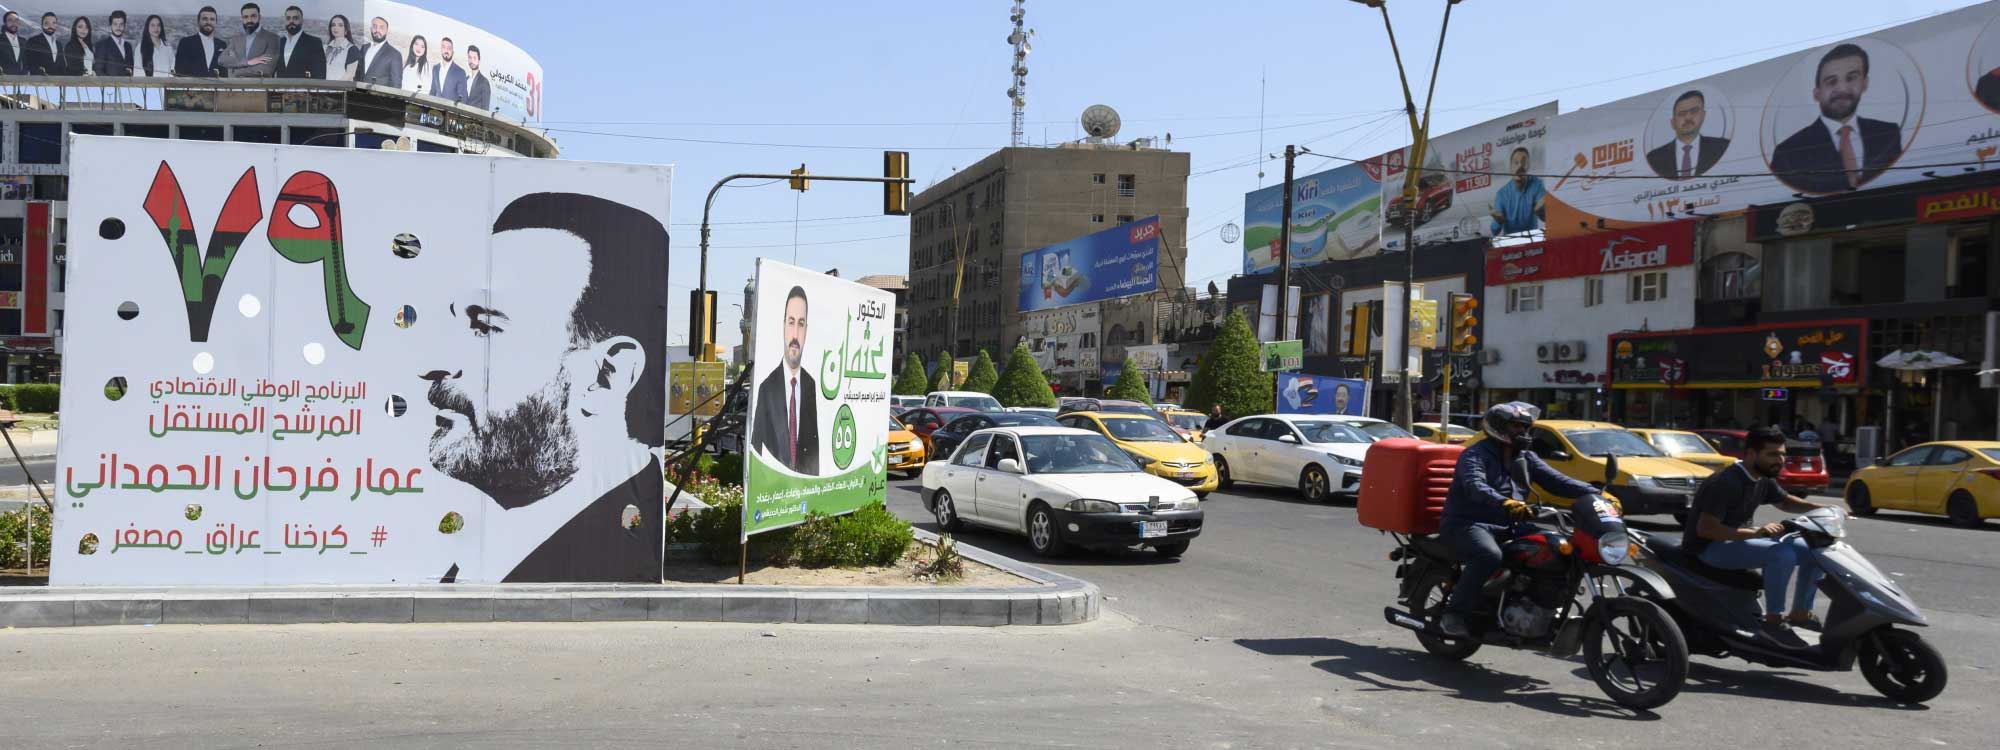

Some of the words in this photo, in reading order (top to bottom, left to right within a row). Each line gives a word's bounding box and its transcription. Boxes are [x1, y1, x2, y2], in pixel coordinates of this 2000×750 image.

[526, 72, 541, 123] 31
[1297, 181, 1319, 201] Kiri
[1682, 182, 1708, 193] محمد
[1135, 223, 1154, 240] جديد
[143, 160, 371, 350] ٧٩
[1601, 244, 1667, 271] Asiacell
[857, 300, 886, 322] الدكتور
[821, 305, 887, 400] عثمان
[150, 376, 236, 404] الاقتصادي
[241, 379, 300, 406] الوطني
[305, 380, 366, 404] البرنامج
[149, 403, 265, 438] المستقل
[272, 403, 361, 441] المرشح
[835, 425, 852, 450] ٥٥
[66, 452, 221, 508] الحمداني
[233, 455, 339, 501] فرحان
[350, 457, 424, 501] عمار
[869, 476, 885, 497] عزم
